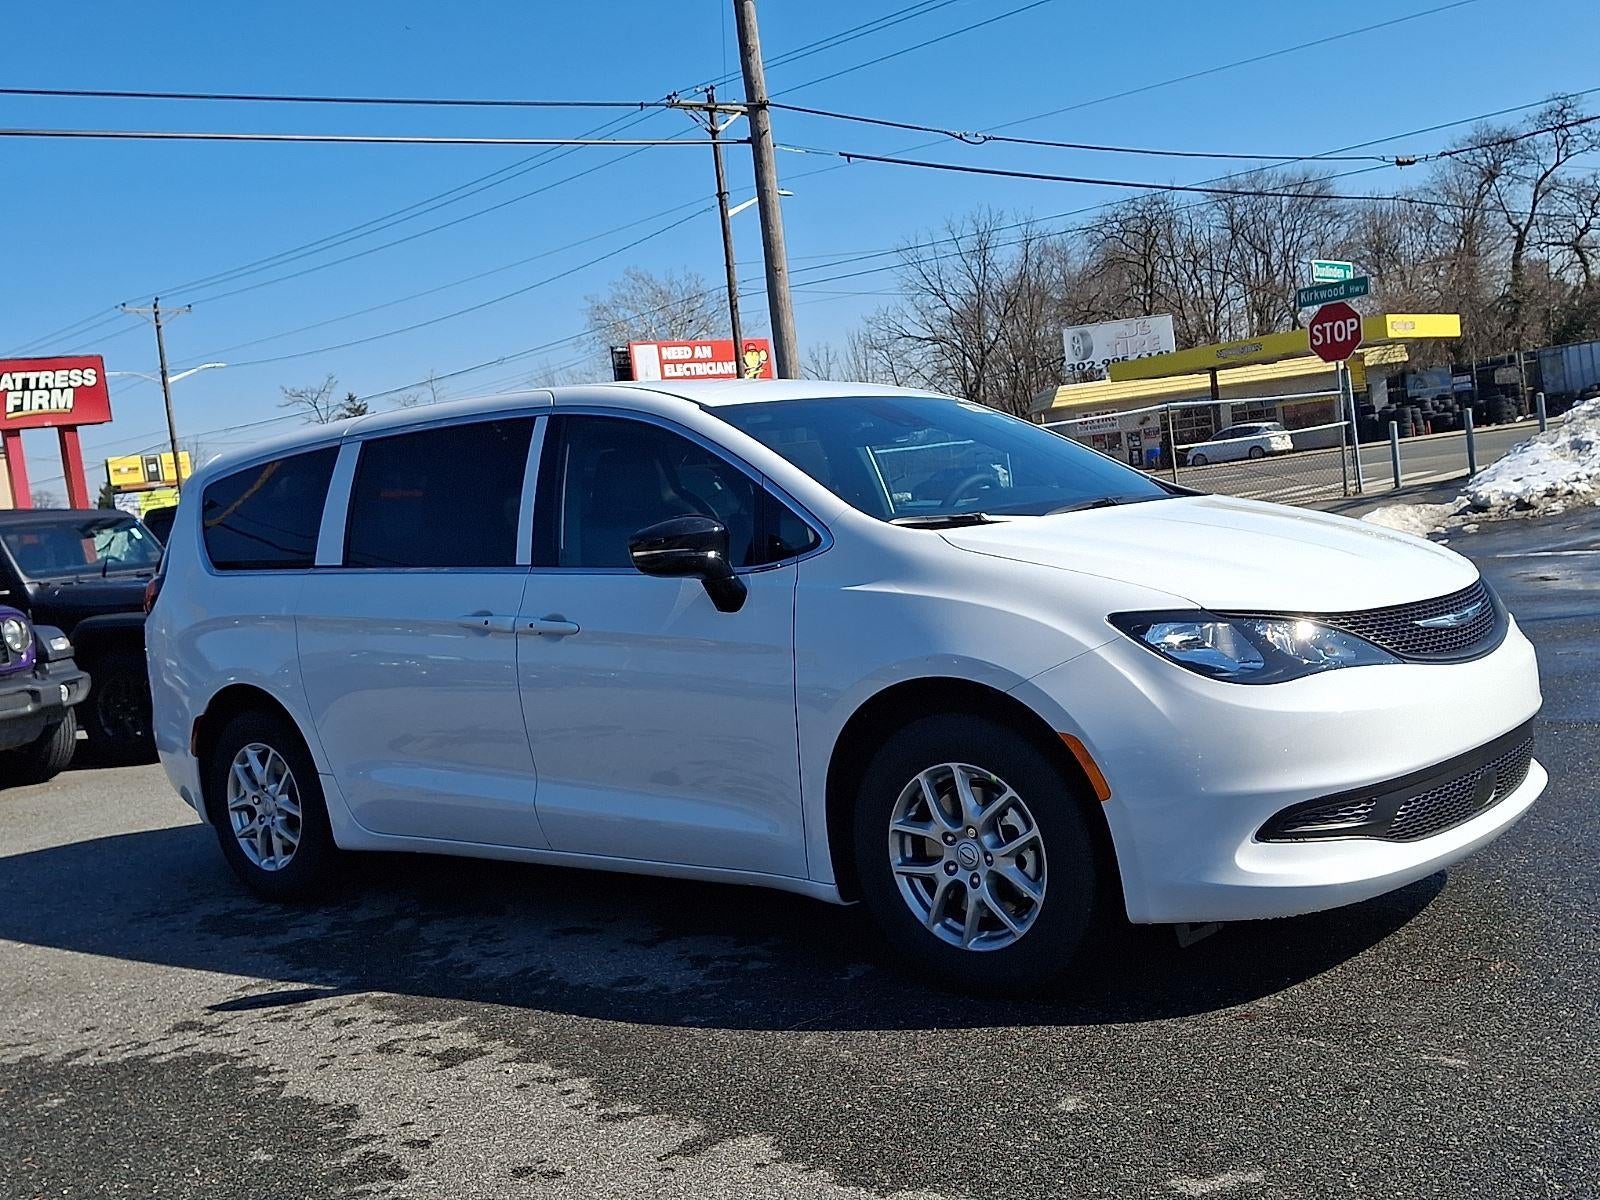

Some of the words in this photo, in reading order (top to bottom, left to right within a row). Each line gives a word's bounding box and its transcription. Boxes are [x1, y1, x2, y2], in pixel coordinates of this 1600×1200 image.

[1300, 284, 1345, 303] Kirkwood
[1312, 317, 1358, 346] STOP
[661, 346, 692, 360] NEED
[694, 345, 712, 359] AN
[1106, 335, 1161, 357] TIRE
[6, 388, 74, 413] FIRM
